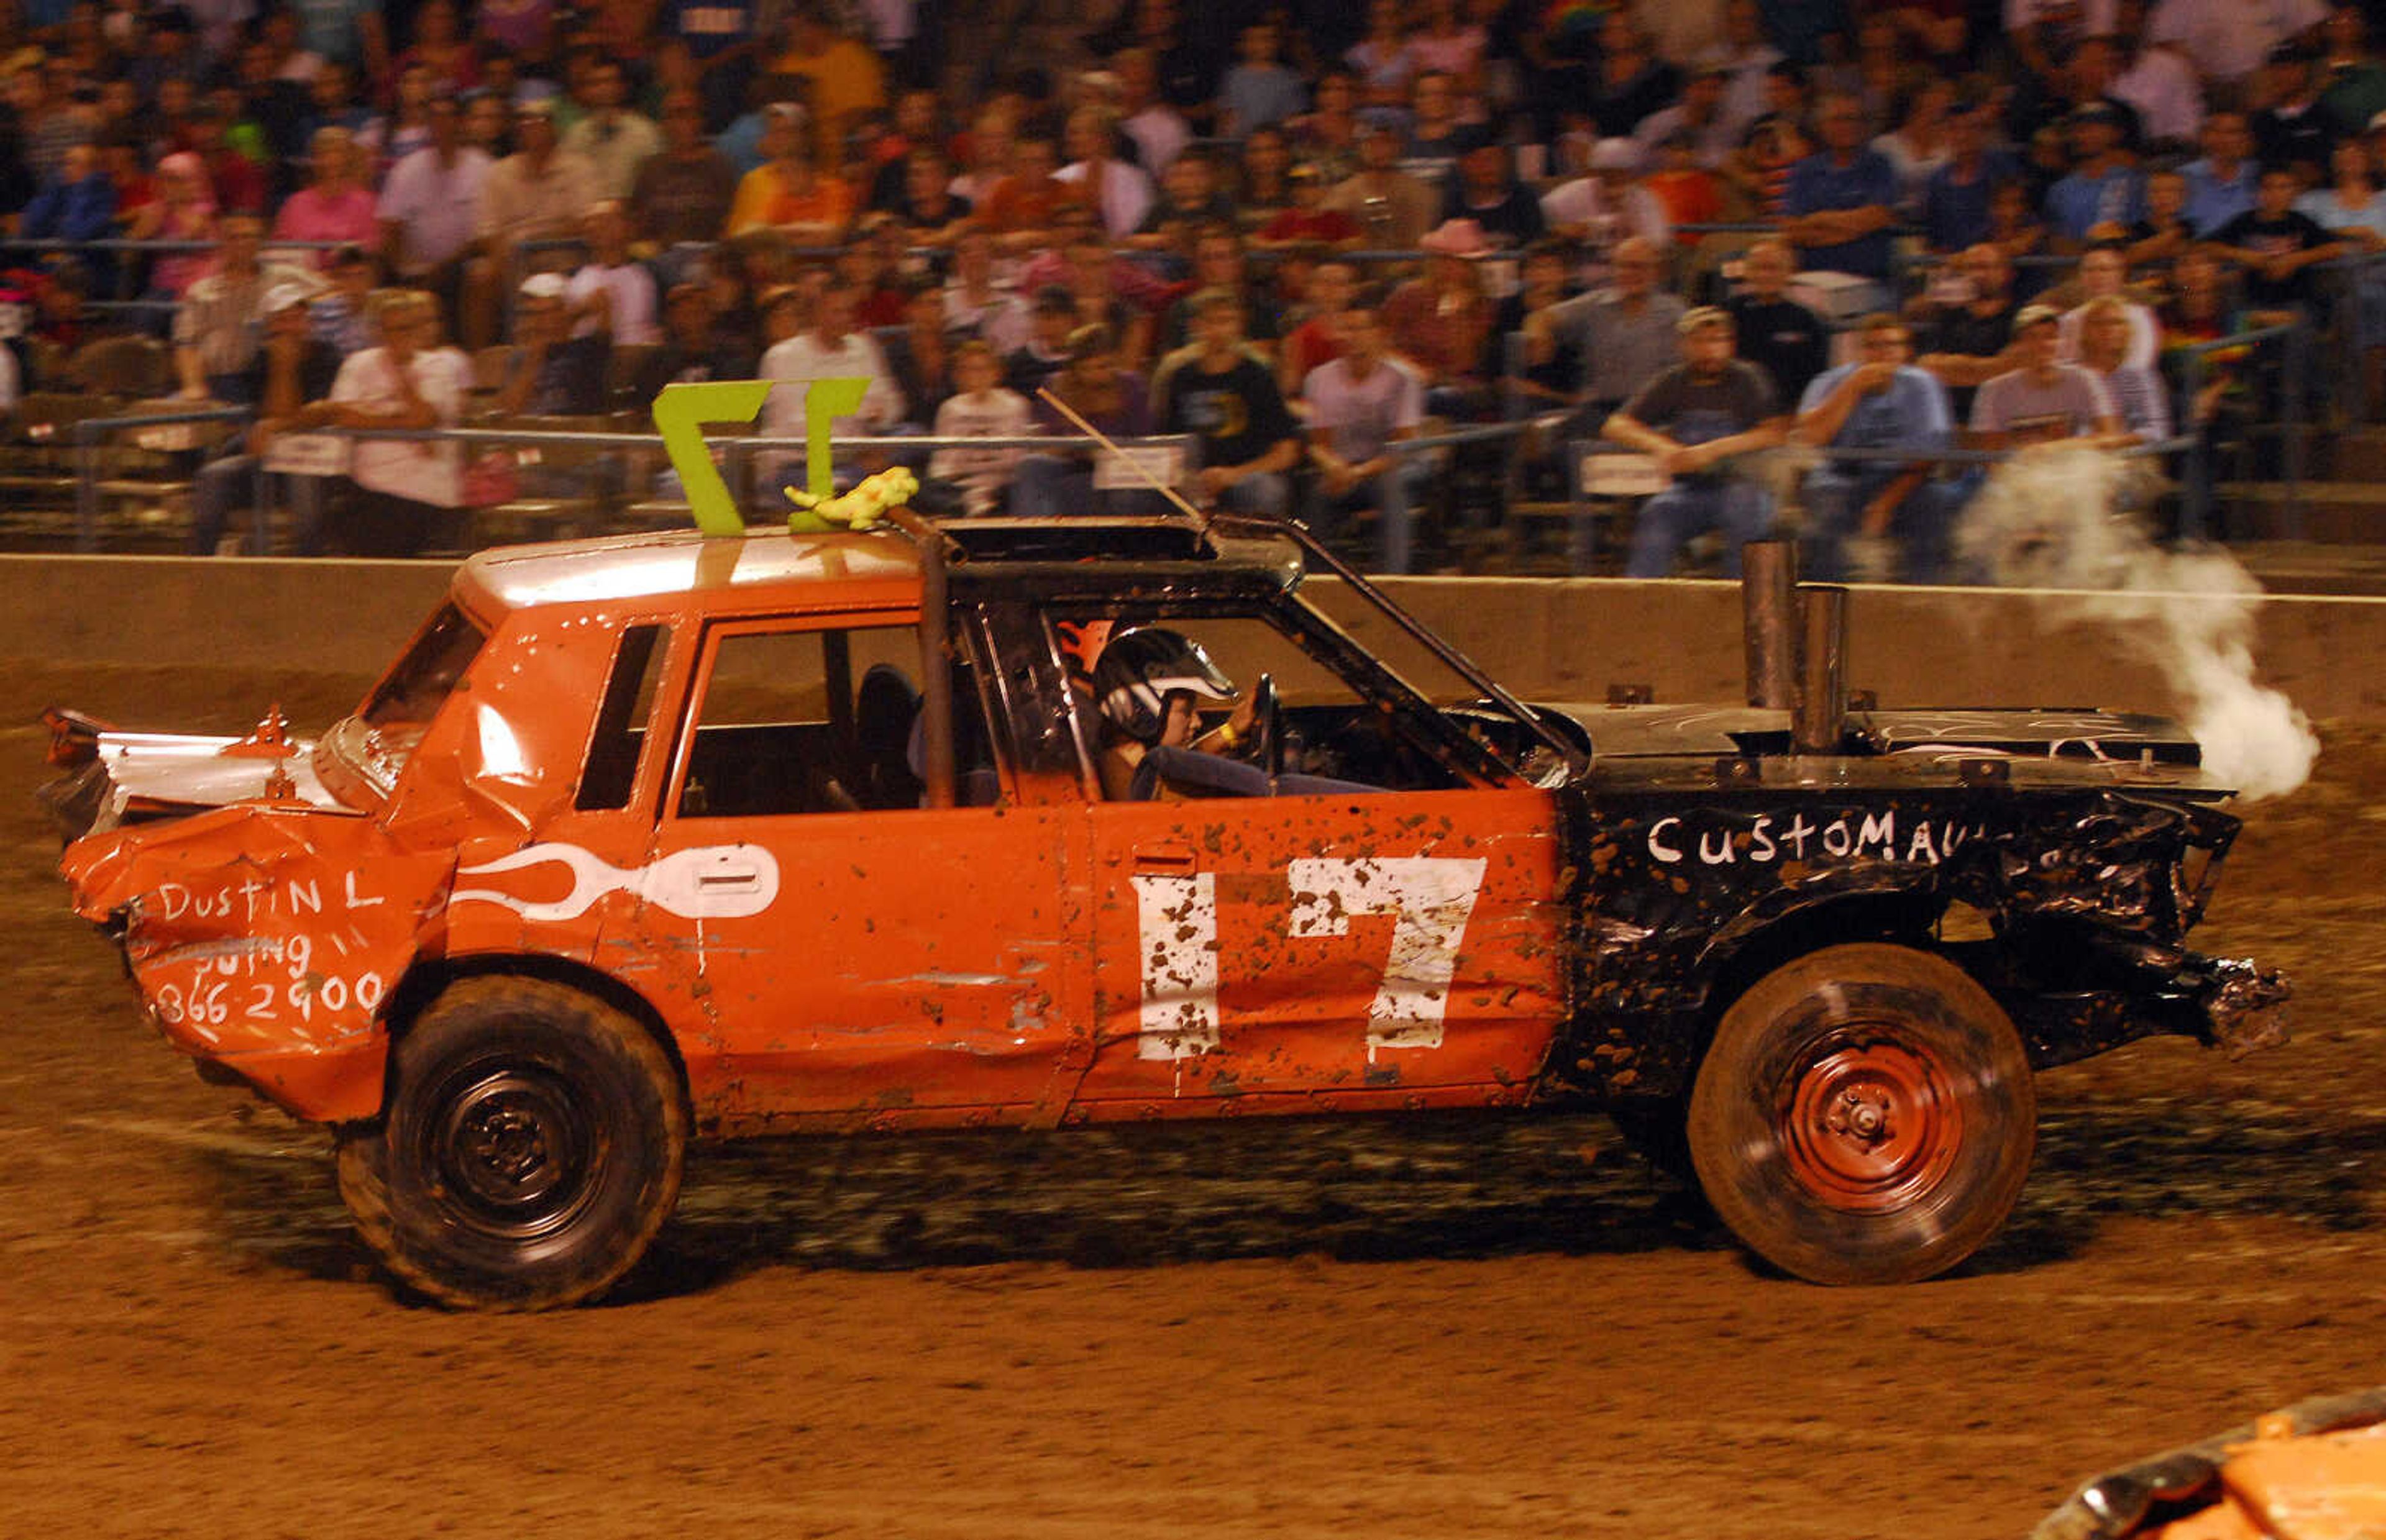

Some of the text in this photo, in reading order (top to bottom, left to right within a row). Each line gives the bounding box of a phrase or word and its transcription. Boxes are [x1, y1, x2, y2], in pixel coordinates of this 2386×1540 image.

[158, 870, 385, 922] DustiN L
[1131, 857, 1488, 1060] 17
